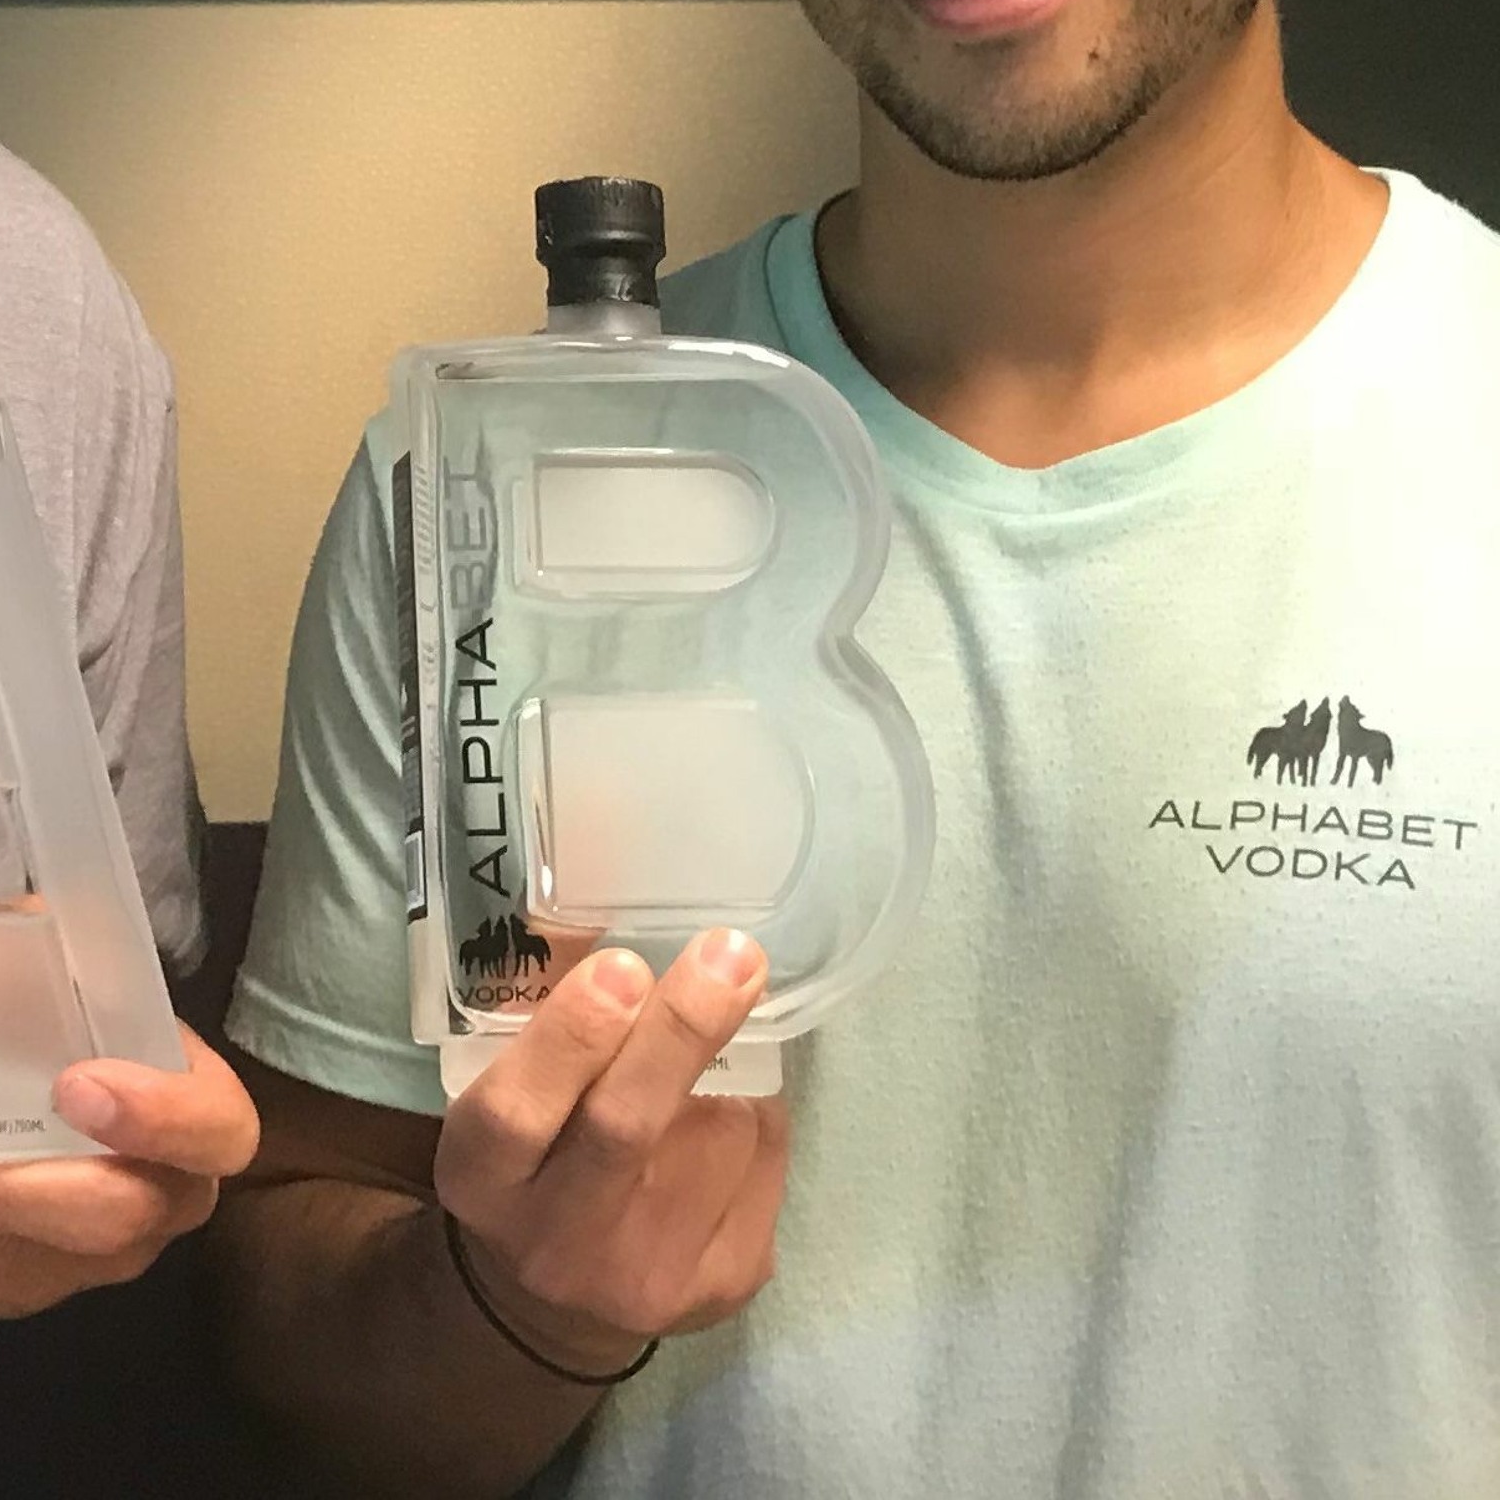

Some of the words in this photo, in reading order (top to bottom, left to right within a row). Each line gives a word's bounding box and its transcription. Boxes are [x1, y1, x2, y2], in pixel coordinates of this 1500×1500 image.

[443, 453, 511, 899] ALPHABET
[1149, 800, 1478, 850] ALPHABET
[1205, 845, 1415, 890] VODKA
[457, 985, 551, 1003] VODKA
